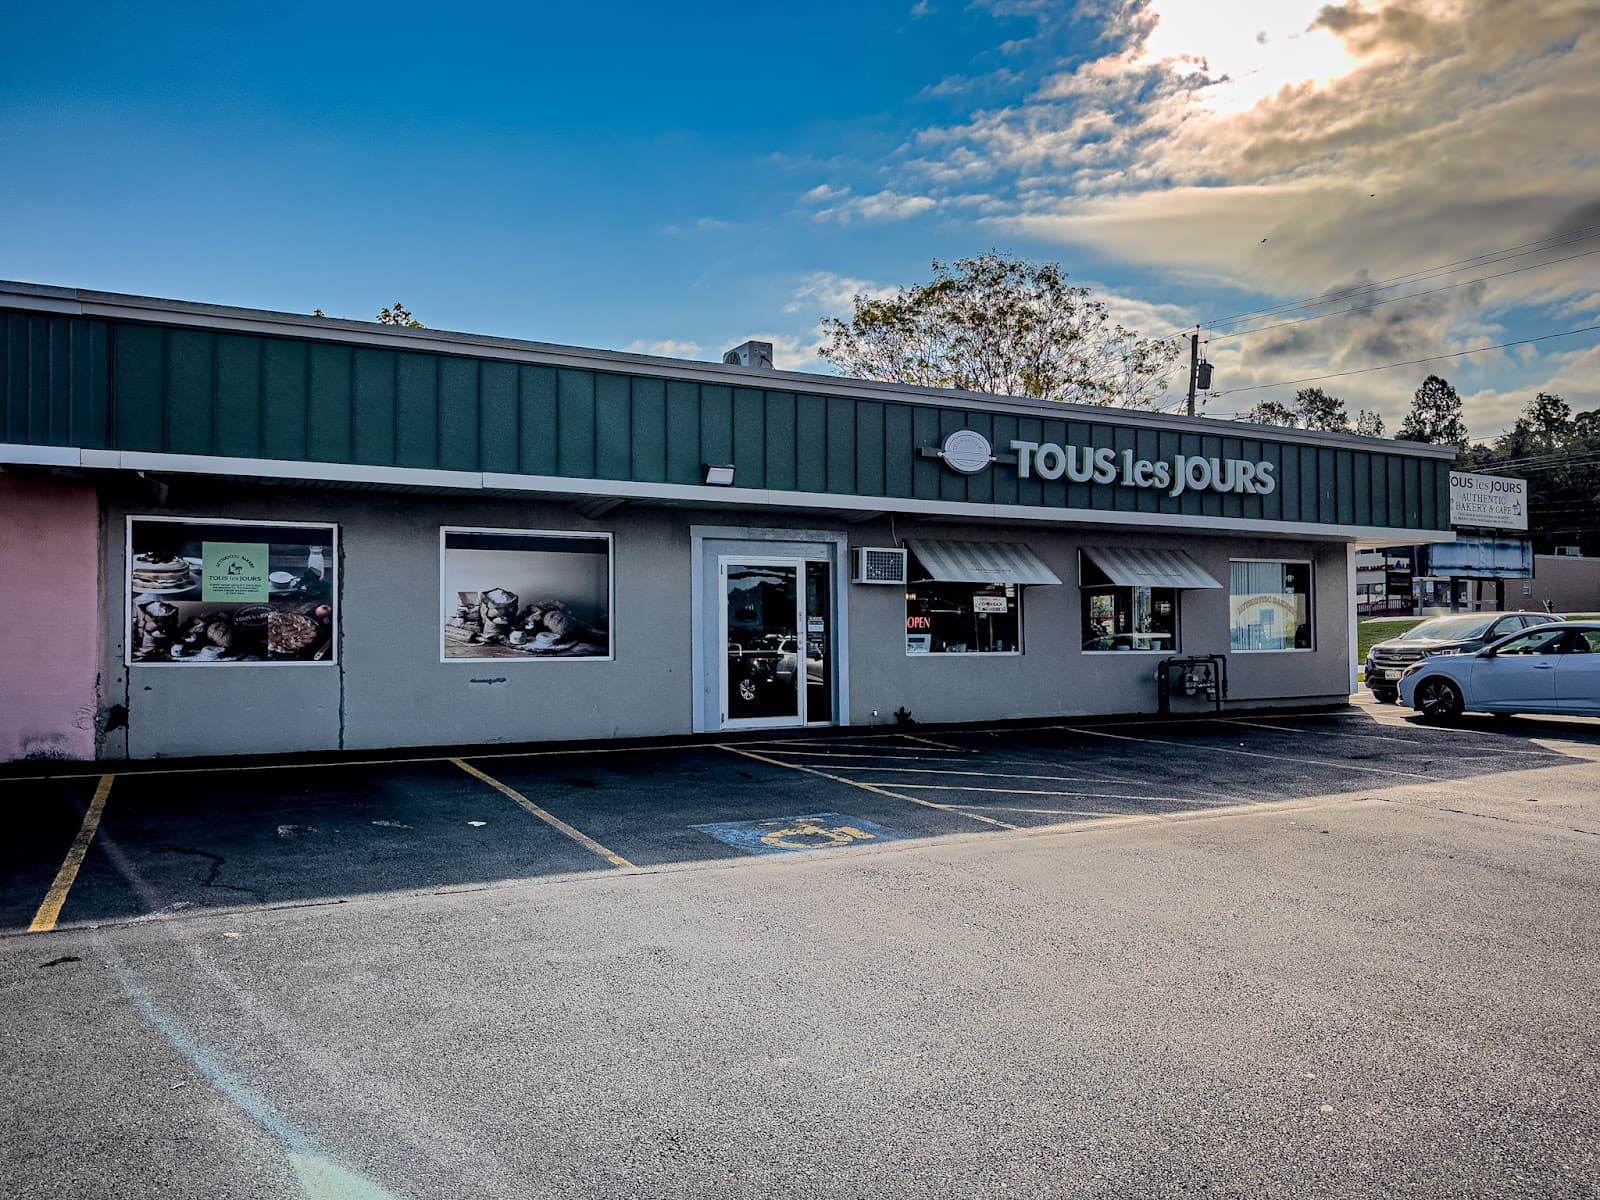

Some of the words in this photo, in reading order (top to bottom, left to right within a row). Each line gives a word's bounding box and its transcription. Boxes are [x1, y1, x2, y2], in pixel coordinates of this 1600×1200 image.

[1010, 440, 1117, 485] TOUS
[1120, 449, 1171, 489] les
[1169, 454, 1276, 498] JOURS
[1451, 476, 1473, 488] OUS
[1475, 479, 1489, 491] les
[1490, 481, 1522, 493] JOURS
[1461, 493, 1506, 505] AUTHENTIC
[1455, 502, 1487, 512] BAKERY
[907, 616, 931, 629] OPEN
